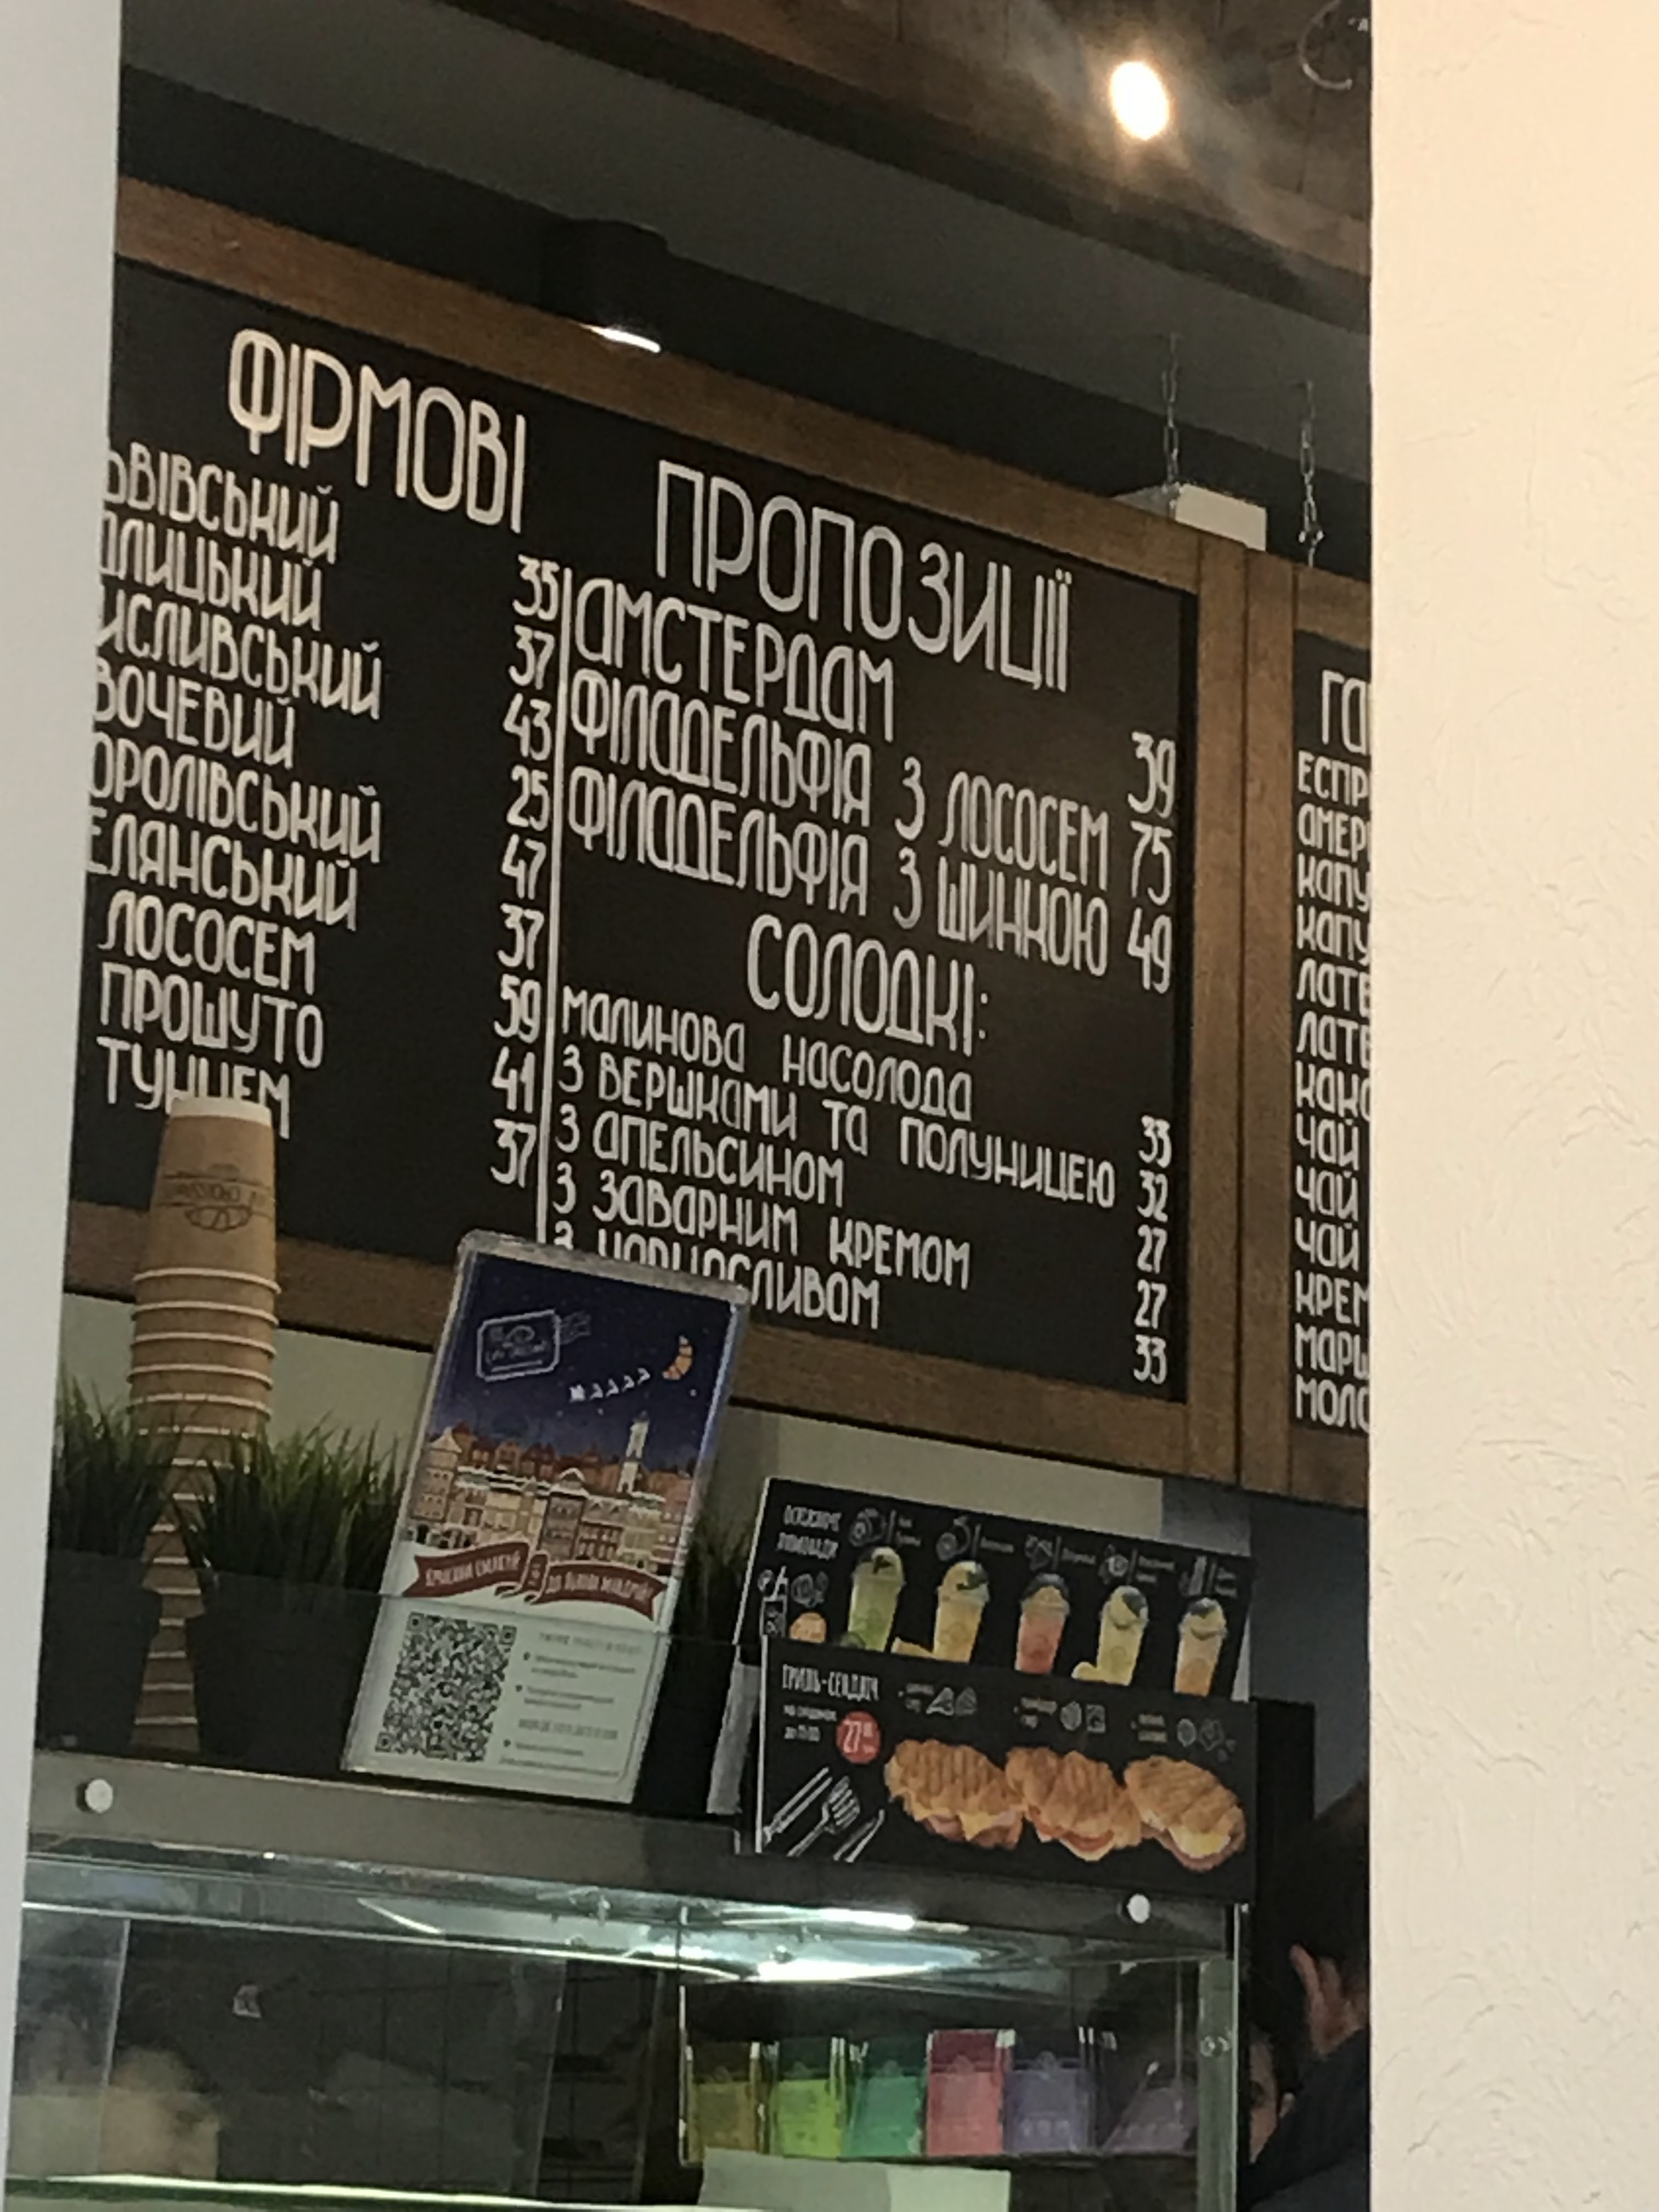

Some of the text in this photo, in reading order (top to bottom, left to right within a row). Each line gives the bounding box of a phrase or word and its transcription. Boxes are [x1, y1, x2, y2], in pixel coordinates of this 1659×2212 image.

[228, 329, 1072, 692] ФІРМОВІ ПРОПОЗИЦІЇ
[513, 554, 560, 621] 35
[509, 624, 555, 690] 37
[503, 693, 552, 761] 43
[574, 578, 1176, 819] АМСТЕРДАМ 39
[1322, 669, 1371, 756] ГА
[507, 765, 549, 831] 25
[571, 668, 871, 827] ФІЛАДЕЛЬФІЯ
[938, 771, 1108, 891] ЛОСОСЕМ
[1130, 820, 1173, 906] 75
[501, 833, 547, 900] 47
[1297, 803, 1371, 863] АМЕР
[568, 766, 868, 916] ФІЛАДЕЛЬФІЯ
[938, 855, 1108, 977] ШИННОЮ
[1127, 907, 1172, 994] 49
[97, 889, 541, 1043] ЛОСОСЕМ 59
[497, 902, 545, 970] 37
[747, 913, 988, 1057] СОЛОДКІ:
[100, 961, 535, 1114] ПРОШУТО 41
[562, 985, 1172, 1167] МАЛИНОВА НАСОЛОДА 33
[490, 1119, 537, 1188] 37
[598, 1052, 798, 1142] ВЕРШКАМИ
[822, 1099, 868, 1156] ТА
[900, 1116, 1115, 1207] ПОЛУНИЦЕЮ
[1137, 1170, 1169, 1222] 32
[1296, 1113, 1359, 1171] ЧАЙ
[592, 1110, 844, 1208] АПЕЛЬСИНОМ
[1137, 1224, 1168, 1274] 27
[1296, 1164, 1359, 1223] ЧАЙ
[592, 1169, 798, 1256] ЗАВАРНИМ
[829, 1216, 970, 1290] КРЕМОМ
[1133, 1279, 1167, 1329] 27
[1295, 1216, 1359, 1272] ЧАЙ
[1133, 1334, 1167, 1385] 33
